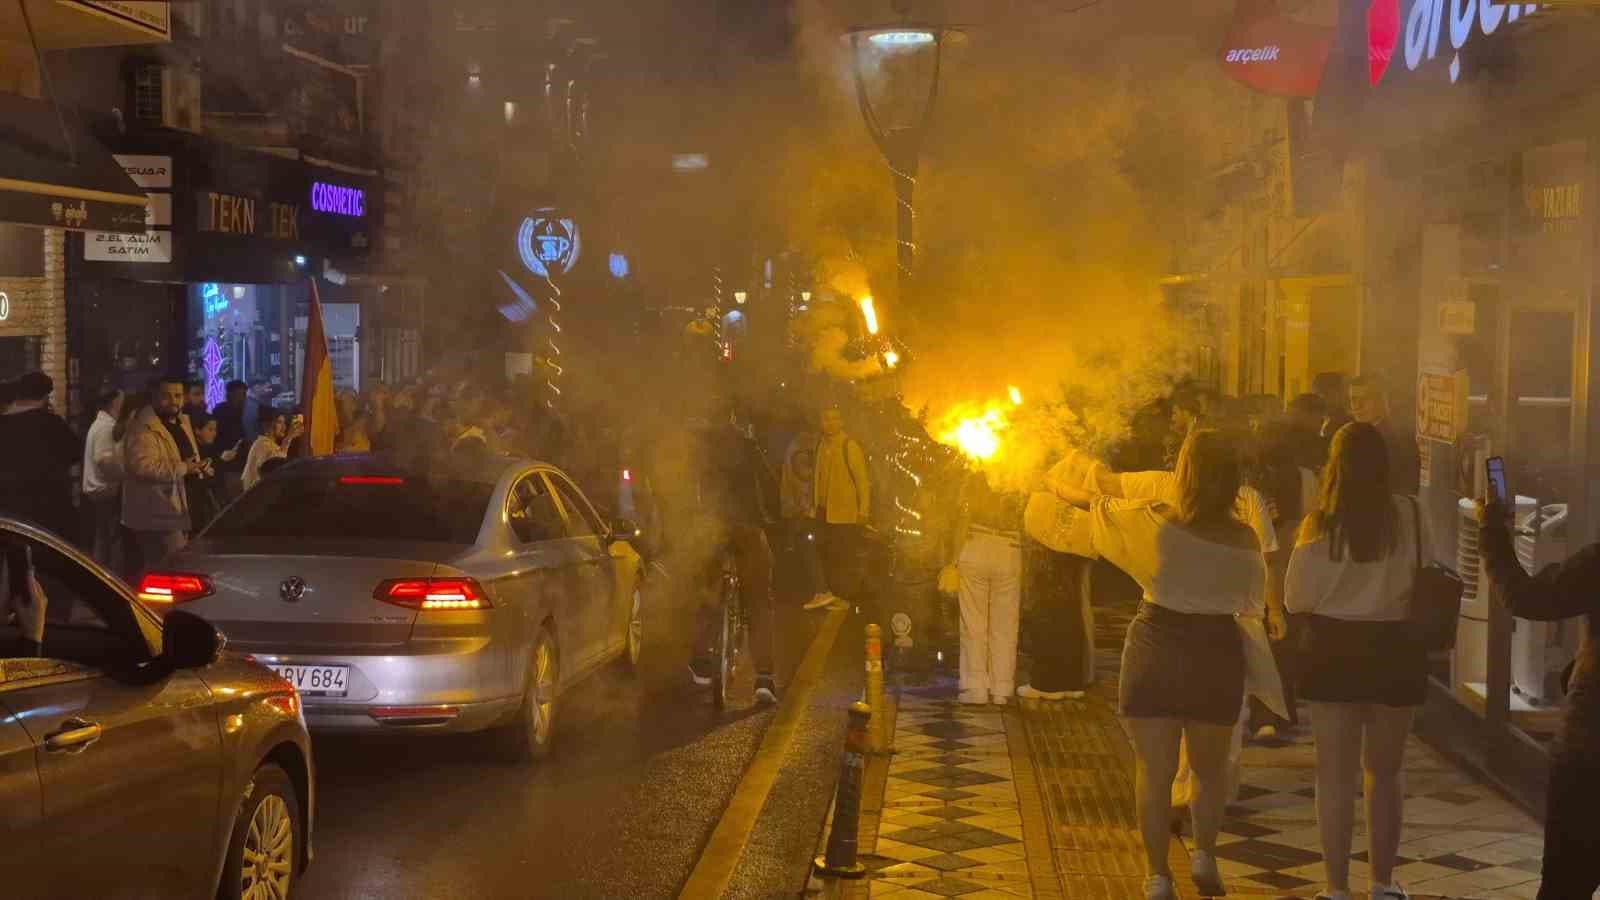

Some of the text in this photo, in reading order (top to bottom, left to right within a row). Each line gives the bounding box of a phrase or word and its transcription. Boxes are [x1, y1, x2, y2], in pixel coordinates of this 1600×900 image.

[1225, 46, 1280, 64] arçelik
[124, 167, 167, 176] SUAR
[312, 181, 363, 217] COSMETIC
[107, 246, 150, 255] SATIM
[311, 668, 344, 688] 684
